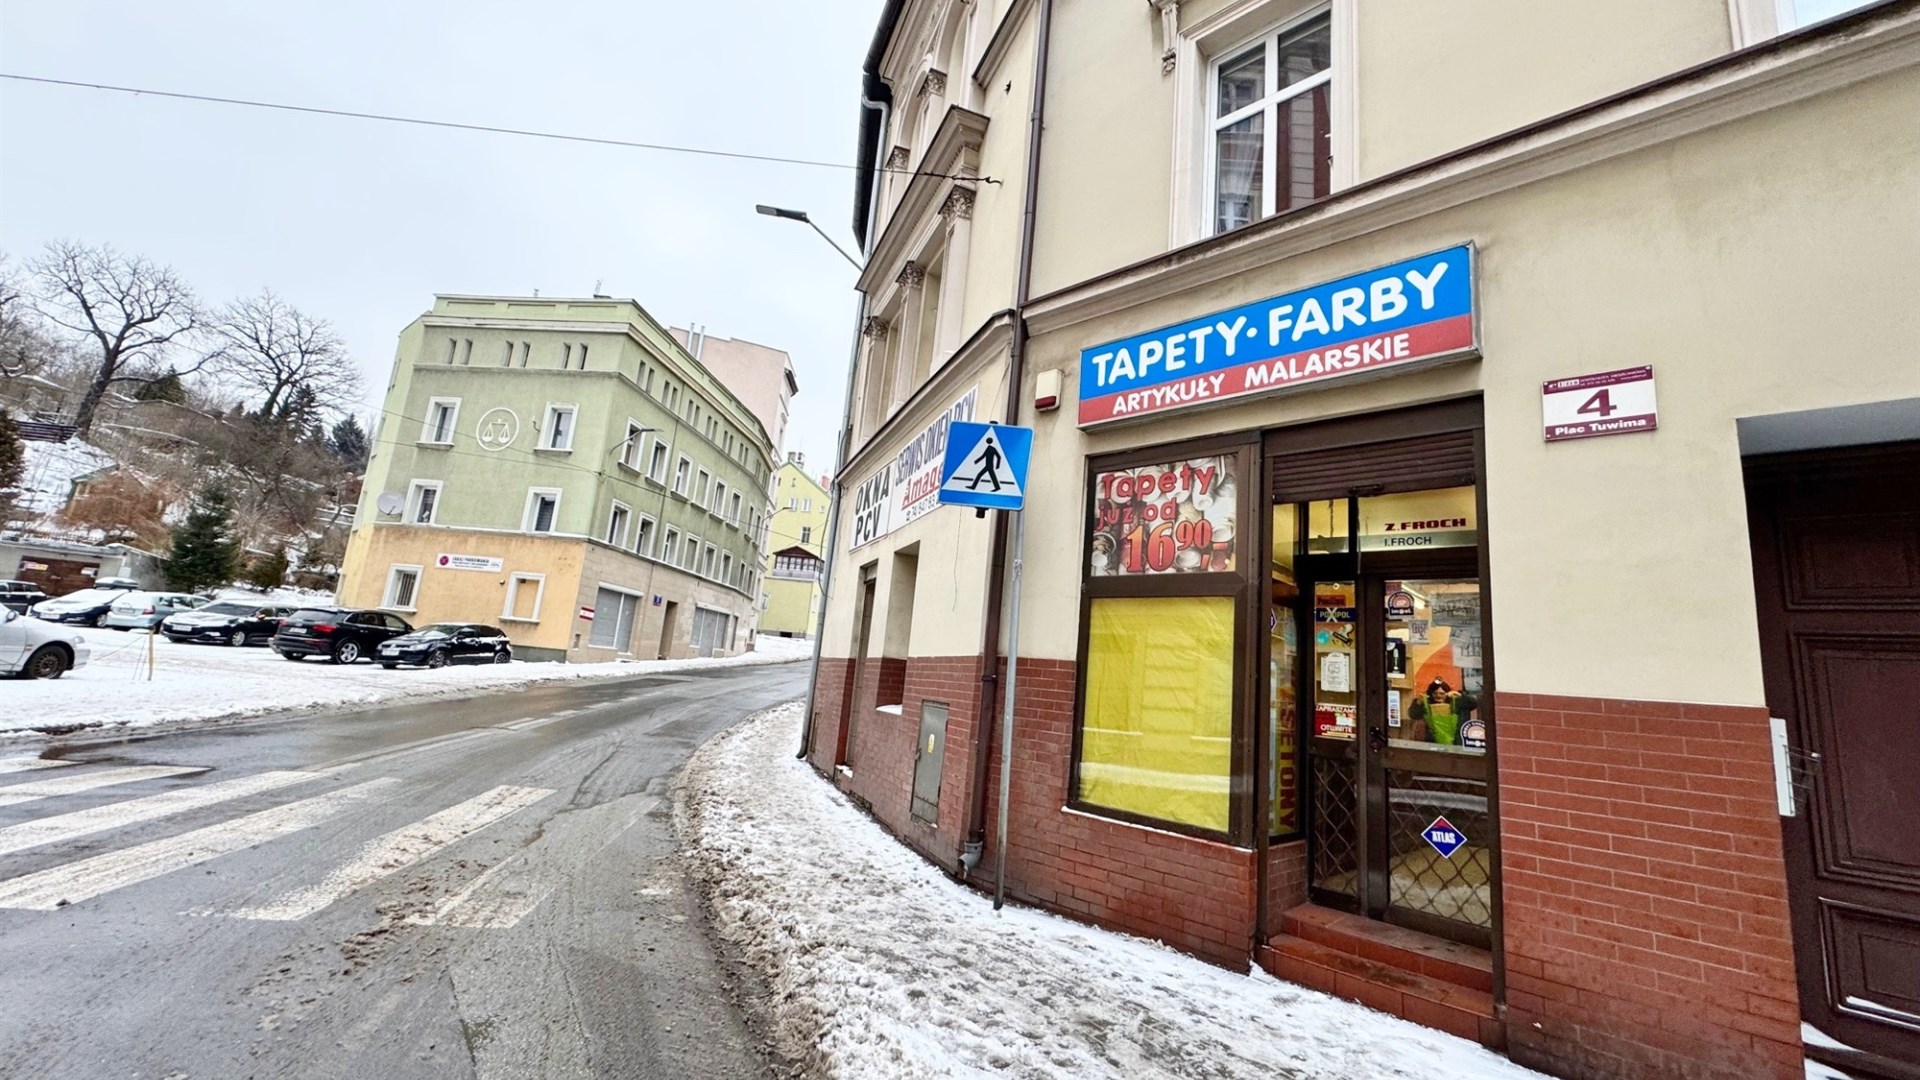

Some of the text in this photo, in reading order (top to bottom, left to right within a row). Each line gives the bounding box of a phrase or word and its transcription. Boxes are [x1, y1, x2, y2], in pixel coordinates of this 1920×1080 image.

[1269, 262, 1449, 347] FARBY
[1112, 333, 1411, 415] ARTYKUŁY MALARSKIE
[1577, 388, 1617, 417] 4
[1555, 418, 1647, 436] Plac Tuwima
[855, 465, 890, 516] OKNA
[1102, 461, 1215, 502] Tapety
[1143, 497, 1178, 522] od
[854, 503, 882, 547] PCV
[1384, 517, 1467, 532] Z.FROCH
[1384, 536, 1432, 547] I.FROCH
[1430, 830, 1456, 844] ATLAS
